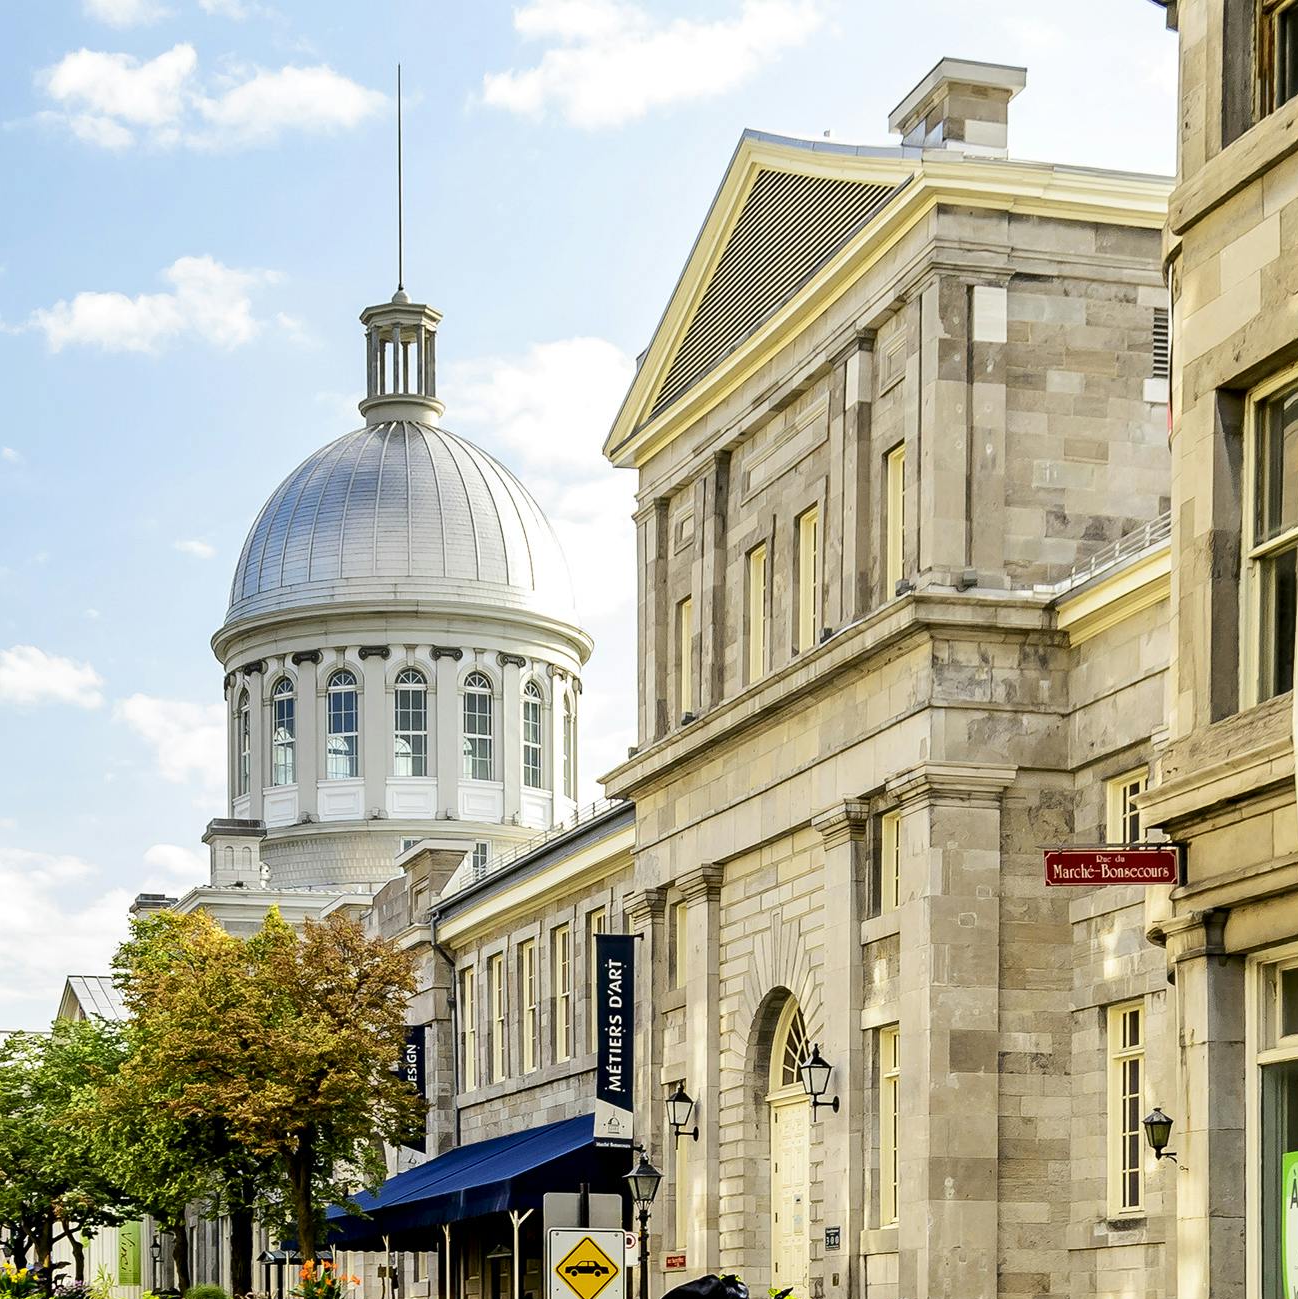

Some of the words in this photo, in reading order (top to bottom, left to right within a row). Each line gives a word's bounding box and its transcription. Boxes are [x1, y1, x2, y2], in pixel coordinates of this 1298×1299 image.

[1053, 864, 1169, 879] Marché-Bonsecours
[1096, 855, 1111, 863] Rue
[1115, 855, 1125, 863] du
[607, 958, 622, 1008] D'ART
[606, 1014, 622, 1092] MÉTIERS
[1289, 1169, 1298, 1209] À
